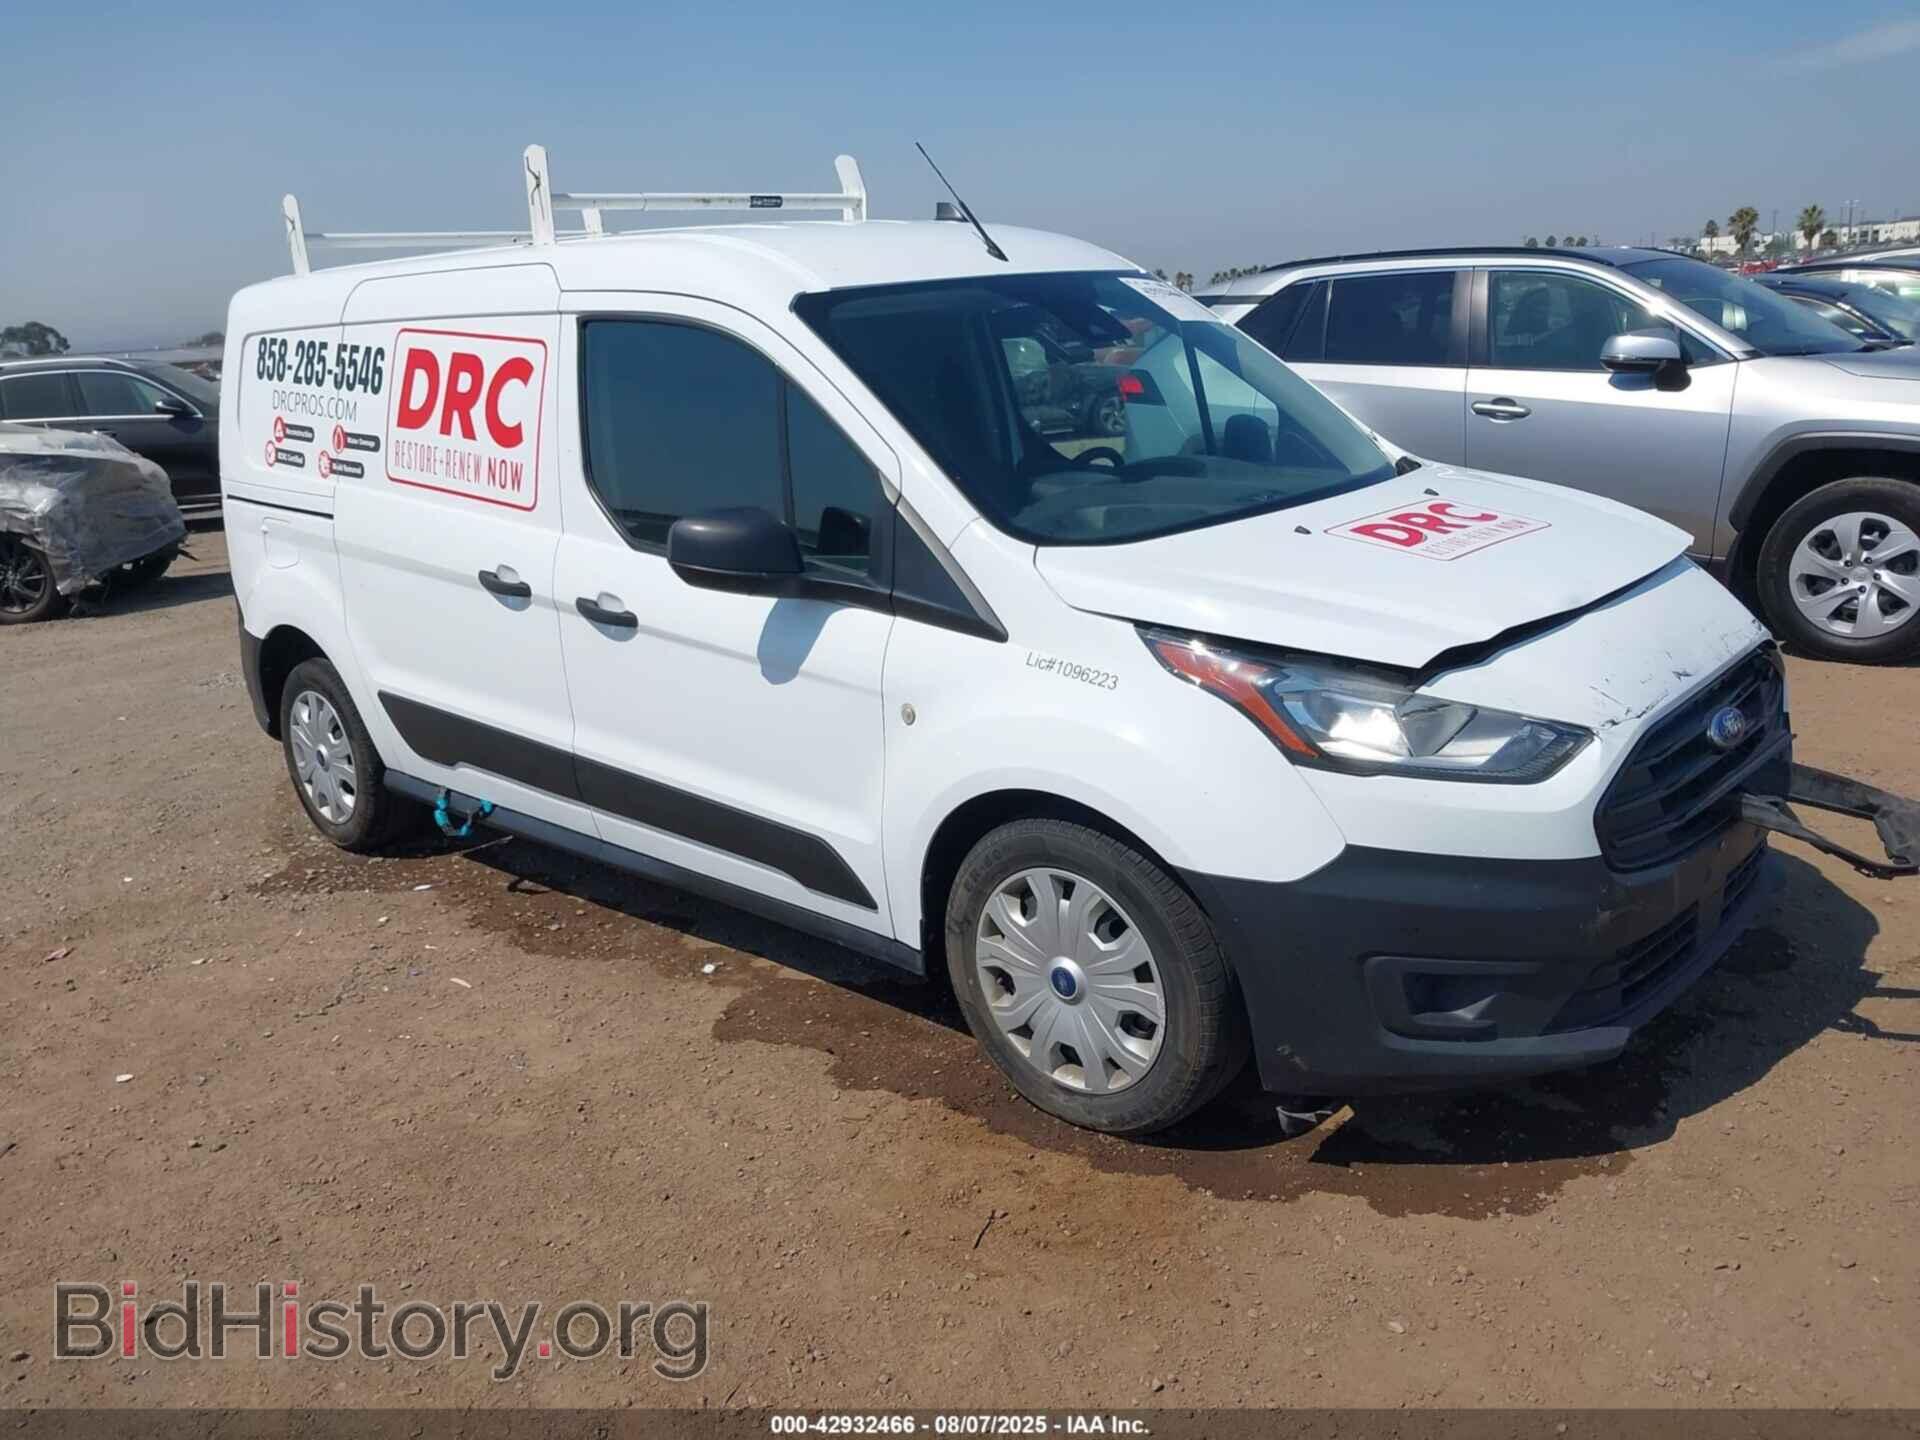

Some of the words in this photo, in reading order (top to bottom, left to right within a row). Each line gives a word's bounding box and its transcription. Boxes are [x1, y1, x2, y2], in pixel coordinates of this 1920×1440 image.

[257, 337, 385, 395] 858-285-5546
[272, 390, 357, 422] DRCPROS.COM
[396, 347, 535, 449] DRC
[487, 456, 524, 492] NOW
[1349, 503, 1498, 547] DRC
[1025, 651, 1119, 690] Lic#1096223
